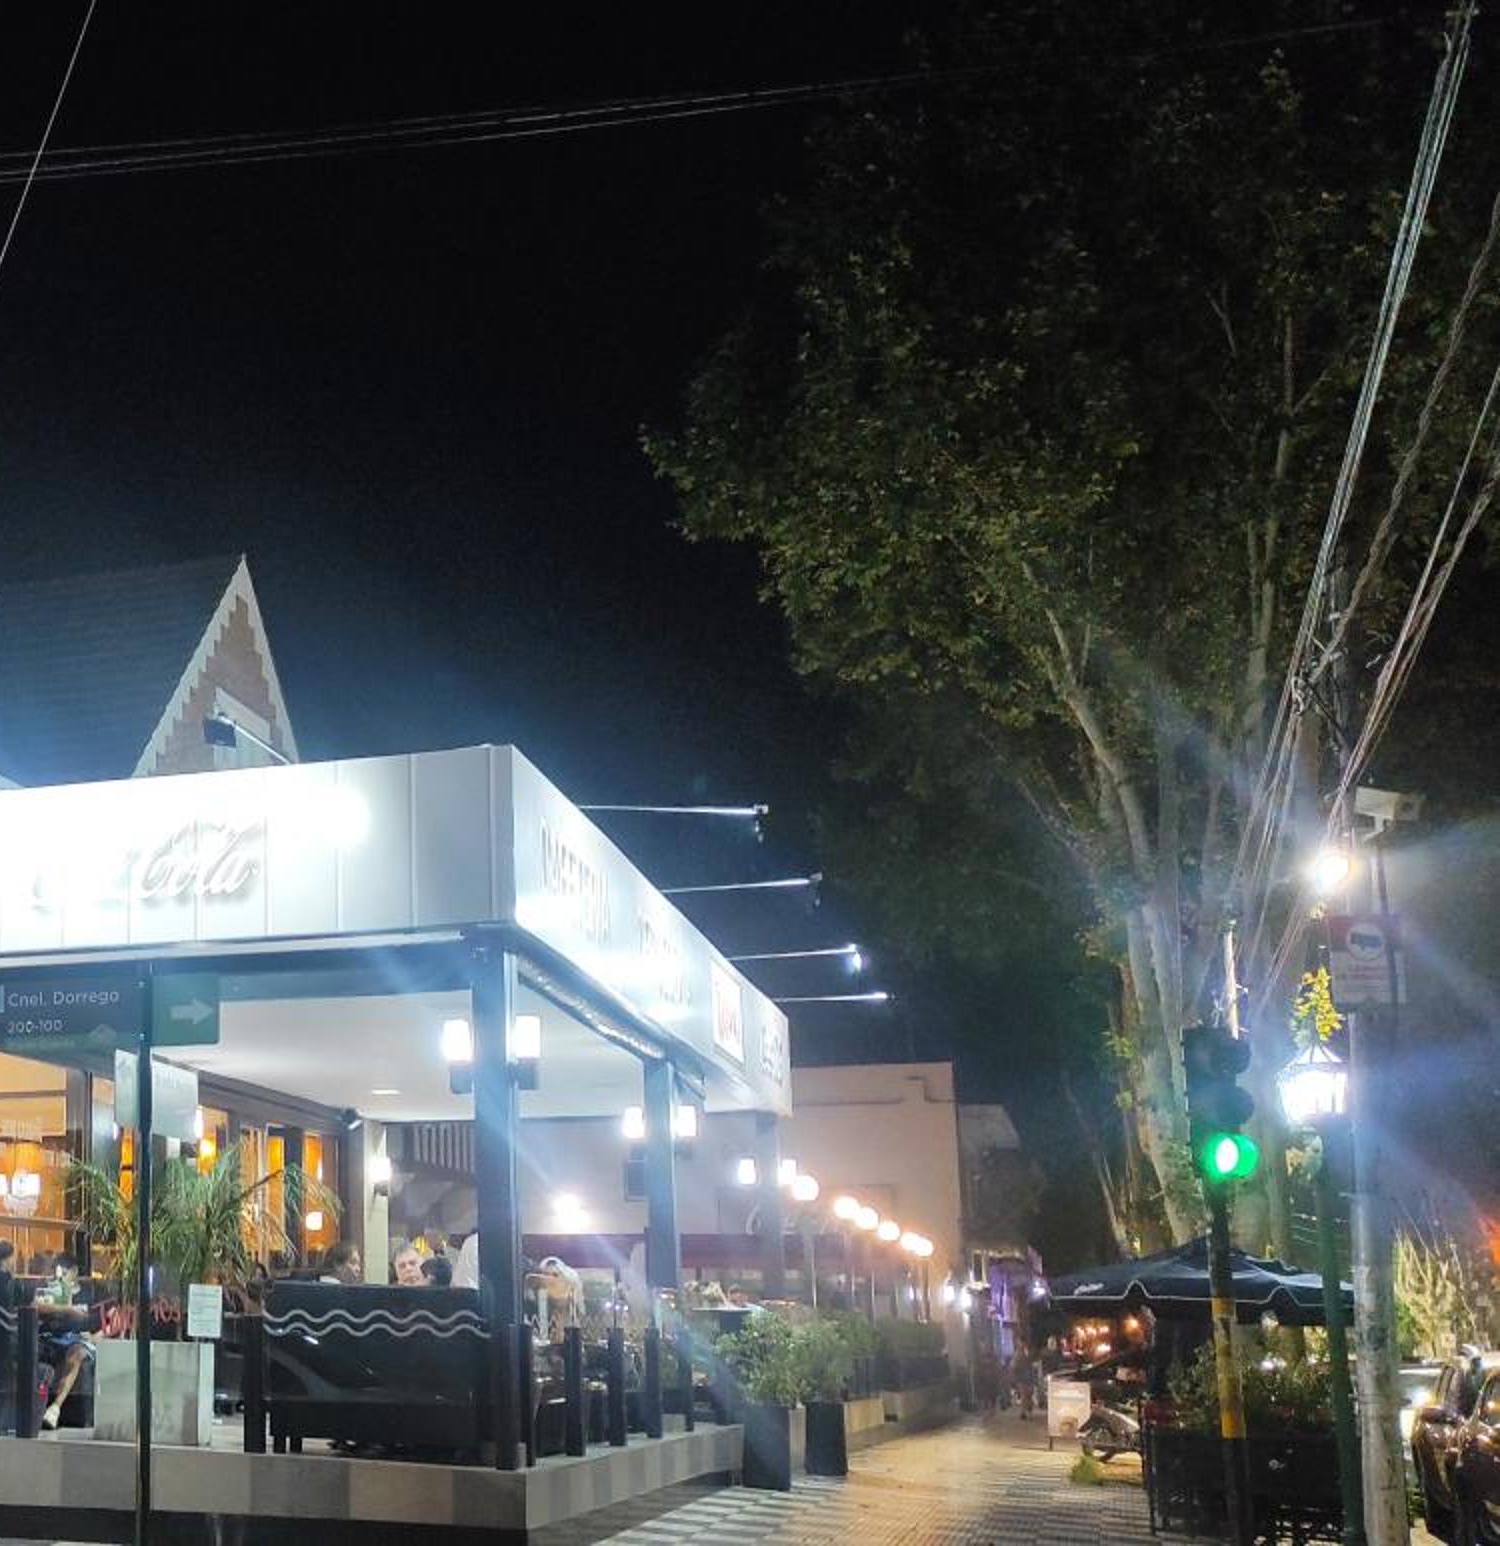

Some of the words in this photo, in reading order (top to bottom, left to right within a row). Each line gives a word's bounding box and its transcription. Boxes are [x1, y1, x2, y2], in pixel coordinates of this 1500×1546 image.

[7, 992, 47, 1007] Cnel.
[53, 991, 120, 1005] Dorrego
[7, 1019, 63, 1034] 200-100
